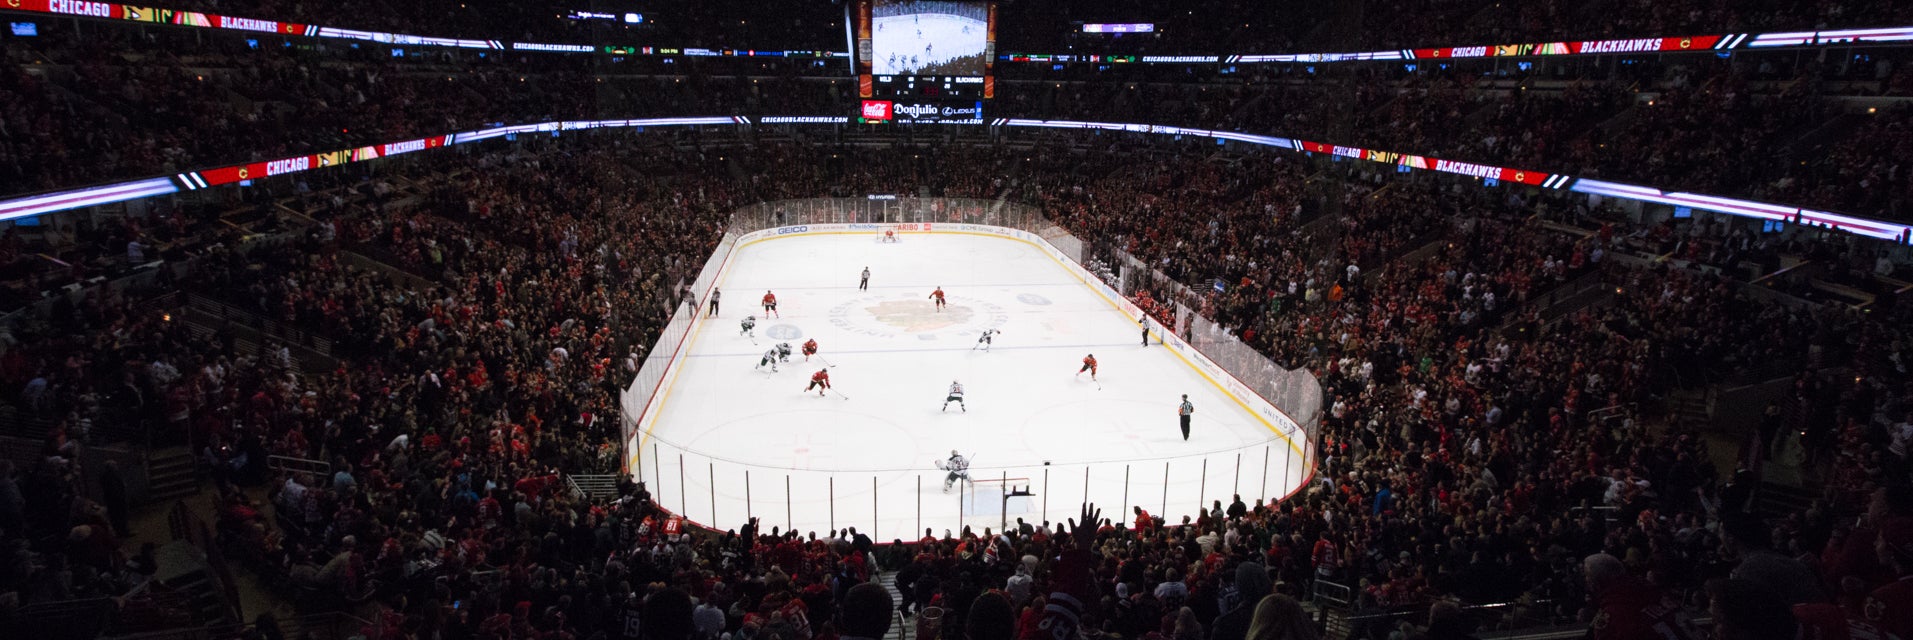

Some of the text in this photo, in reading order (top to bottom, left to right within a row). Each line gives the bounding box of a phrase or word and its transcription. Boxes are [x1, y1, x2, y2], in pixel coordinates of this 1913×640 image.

[49, 0, 110, 17] CHICAGO
[220, 16, 278, 32] BLACKHAWKS
[1451, 46, 1486, 57] CHICAGO
[1580, 38, 1663, 53] BLACKHAWKS
[267, 157, 309, 176] CHICAGO
[384, 139, 425, 156] BLACKHAWKS
[1333, 145, 1361, 158] CHICAGO
[1436, 160, 1502, 179] BLACKHAWKS
[778, 226, 807, 234] GEICO
[1263, 407, 1288, 429] UNITED
[666, 522, 677, 532] 81
